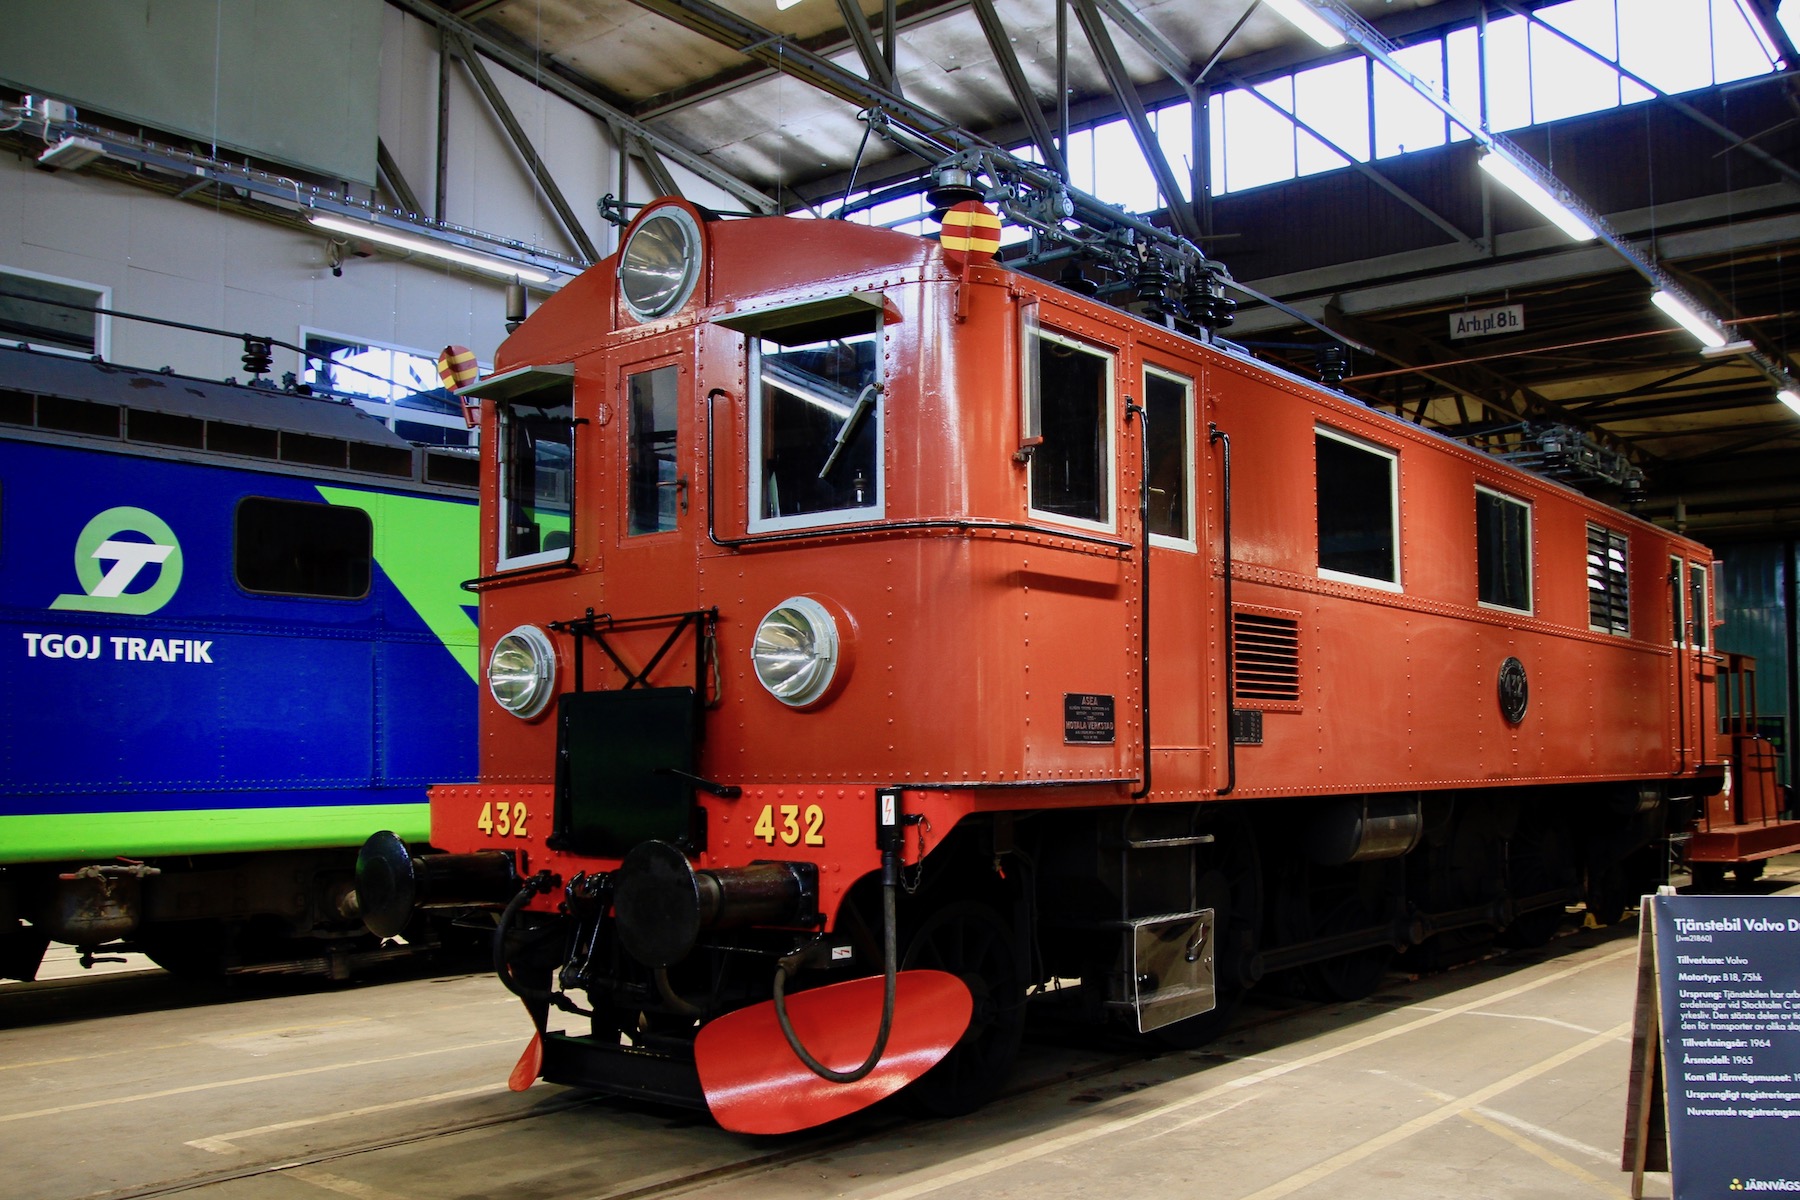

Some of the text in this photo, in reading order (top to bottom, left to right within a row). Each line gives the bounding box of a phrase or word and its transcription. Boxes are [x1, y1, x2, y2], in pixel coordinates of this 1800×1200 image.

[23, 633, 213, 664] TGOJ TRAFIK
[1081, 696, 1098, 706] ASEA
[1065, 721, 1087, 730] MOTALA
[478, 802, 527, 836] 432
[754, 804, 824, 845] 432
[1673, 917, 1800, 934] Tjänstebil Volvo D
[1676, 955, 1749, 965] Tillverkare: Volvo
[1678, 972, 1722, 983] Motortyp:
[1742, 973, 1763, 982] 75hk
[1679, 989, 1722, 1000] Ursprung:
[1722, 989, 1769, 1000] Tjänstebilen
[1770, 989, 1784, 998] har
[1679, 1000, 1726, 1011] avdelningar
[1727, 1000, 1740, 1009] vid
[1741, 1000, 1782, 1009] Stockholm
[1783, 1000, 1791, 1009] C
[1680, 1010, 1711, 1021] yrkesliv.
[1712, 1011, 1729, 1020] Den
[1730, 1011, 1756, 1020] största
[1756, 1010, 1780, 1020] delen
[1680, 1021, 1697, 1030] den
[1698, 1021, 1710, 1030] för
[1710, 1022, 1753, 1032] transporter
[1754, 1023, 1765, 1031] av
[1765, 1021, 1786, 1031] olika
[1681, 1038, 1771, 1050] Tillverkningsår: 1964
[1682, 1053, 1753, 1065] Årsmodell: 1965
[1684, 1072, 1705, 1081] Kom
[1706, 1072, 1717, 1081] till
[1717, 1072, 1792, 1084] Järnvägsmuseet:
[1685, 1089, 1740, 1101] Ursprungligt
[1686, 1106, 1738, 1116] Nuvarande
[1744, 1178, 1800, 1191] JÄRNVÄGS
